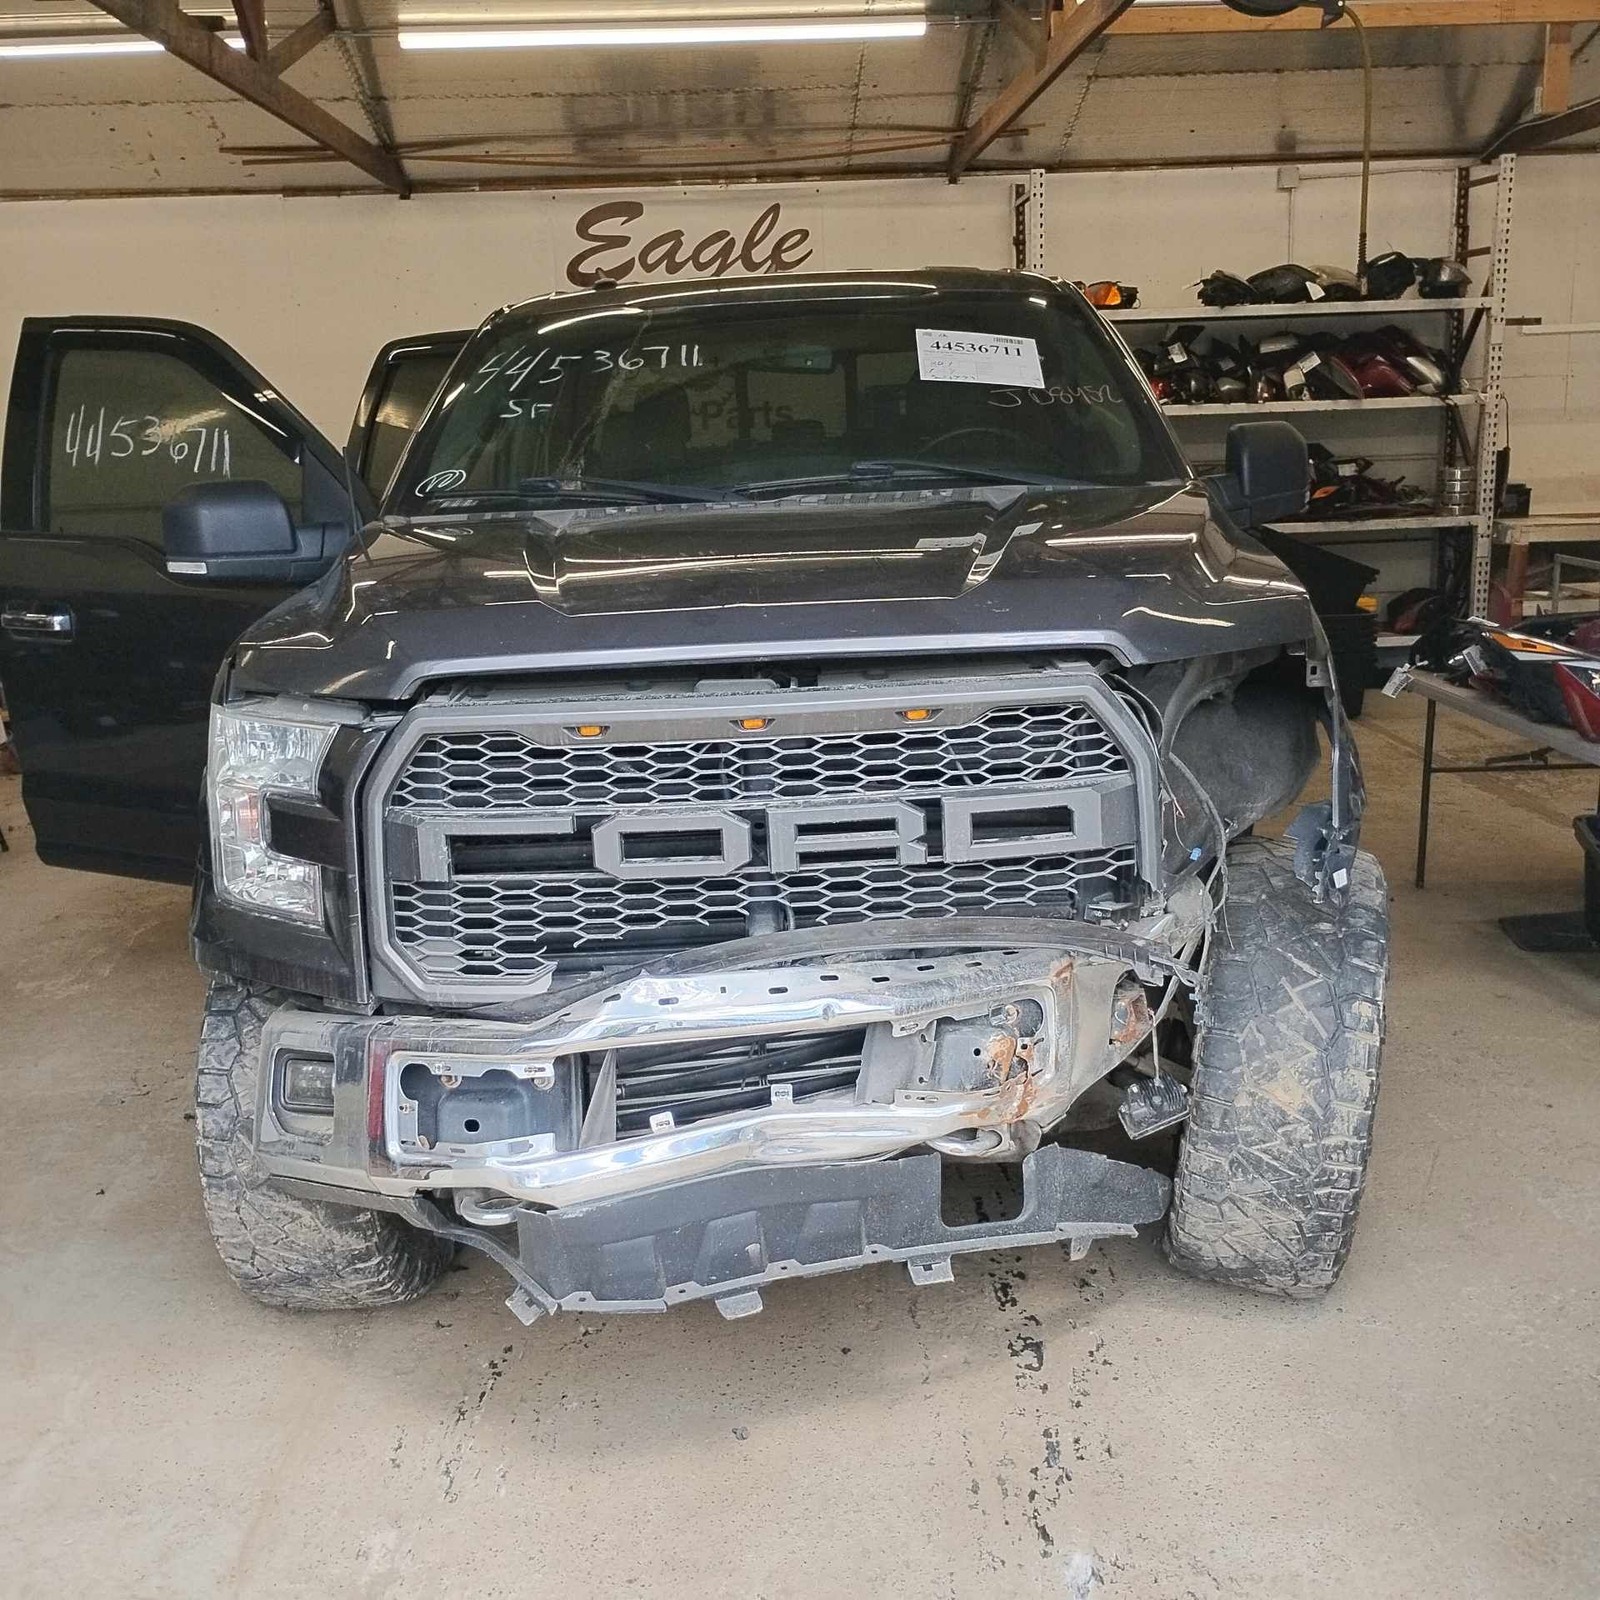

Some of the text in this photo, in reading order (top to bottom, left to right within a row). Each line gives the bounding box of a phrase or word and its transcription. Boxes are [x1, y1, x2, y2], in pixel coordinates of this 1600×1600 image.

[566, 200, 814, 288] Eagle
[929, 340, 1023, 357] 44536711
[64, 404, 232, 480] 44536711
[500, 398, 553, 420] SF
[417, 788, 1102, 884] FORD
